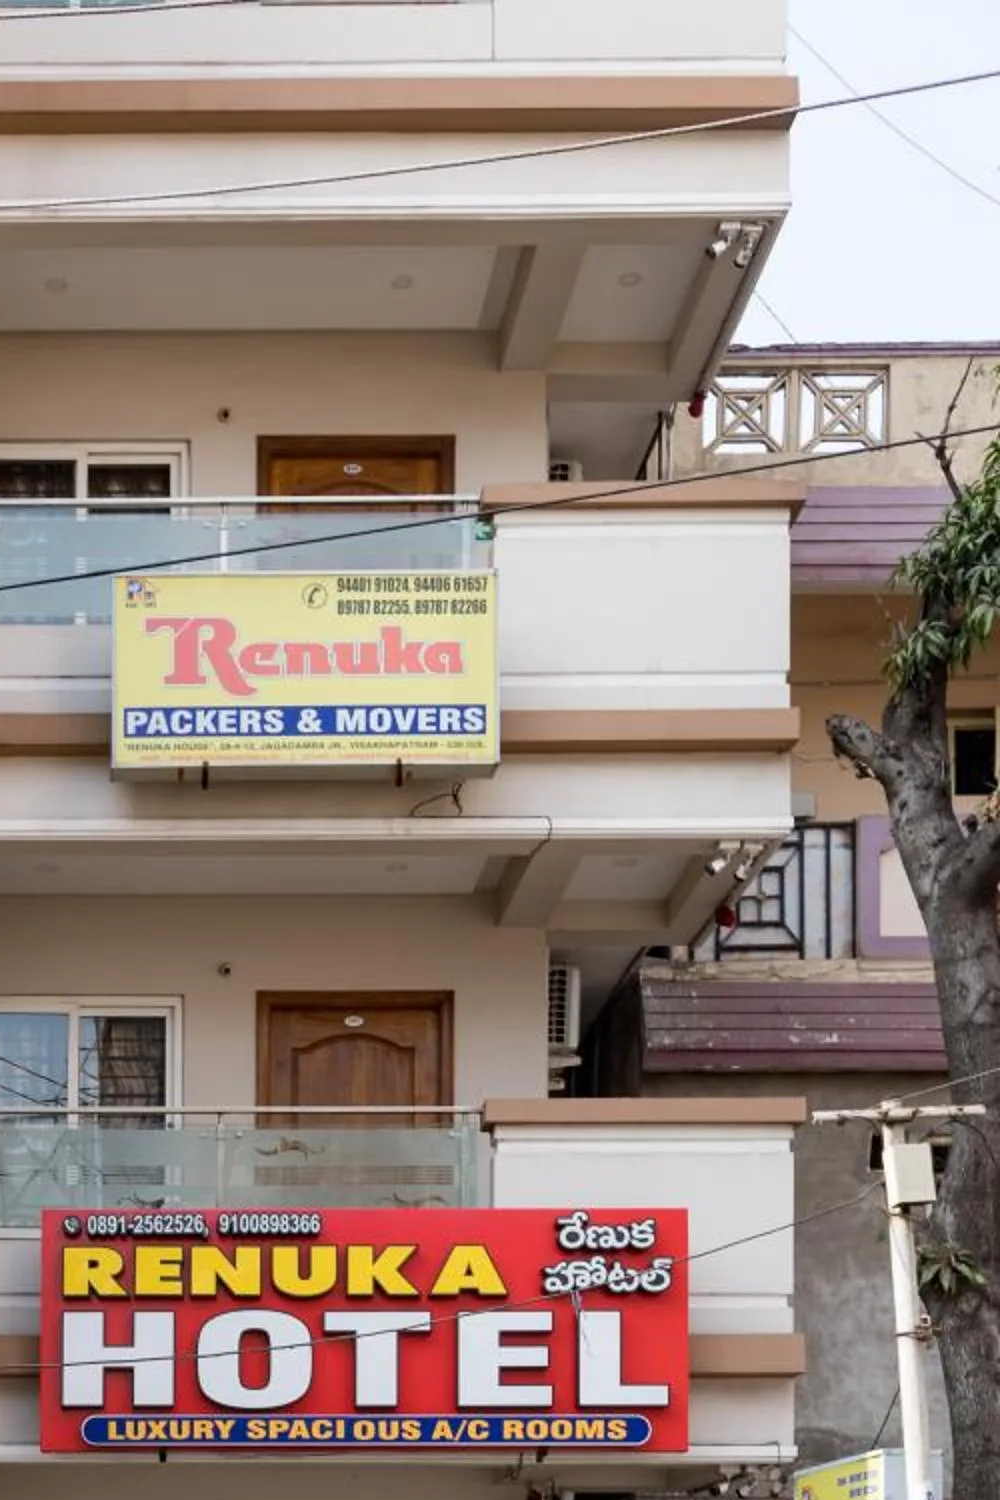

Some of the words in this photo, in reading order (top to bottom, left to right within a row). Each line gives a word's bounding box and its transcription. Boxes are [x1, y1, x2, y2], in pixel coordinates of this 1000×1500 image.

[336, 577, 371, 593] 94401
[414, 577, 450, 592] 94406
[453, 576, 488, 592] 61657
[144, 616, 465, 696] Renuka
[126, 707, 285, 736] PACKERS
[297, 708, 322, 734] &
[337, 705, 485, 733] MOVERS
[87, 1214, 209, 1237] 0891-2562526,
[219, 1213, 321, 1234] 9100898366
[557, 1211, 655, 1249] రేణుక
[63, 1245, 507, 1297] RENUKA
[62, 1309, 669, 1409] HOTEL
[107, 1419, 235, 1440] LUXURY
[431, 1418, 489, 1442] A/C
[503, 1418, 628, 1440] ROOMS
